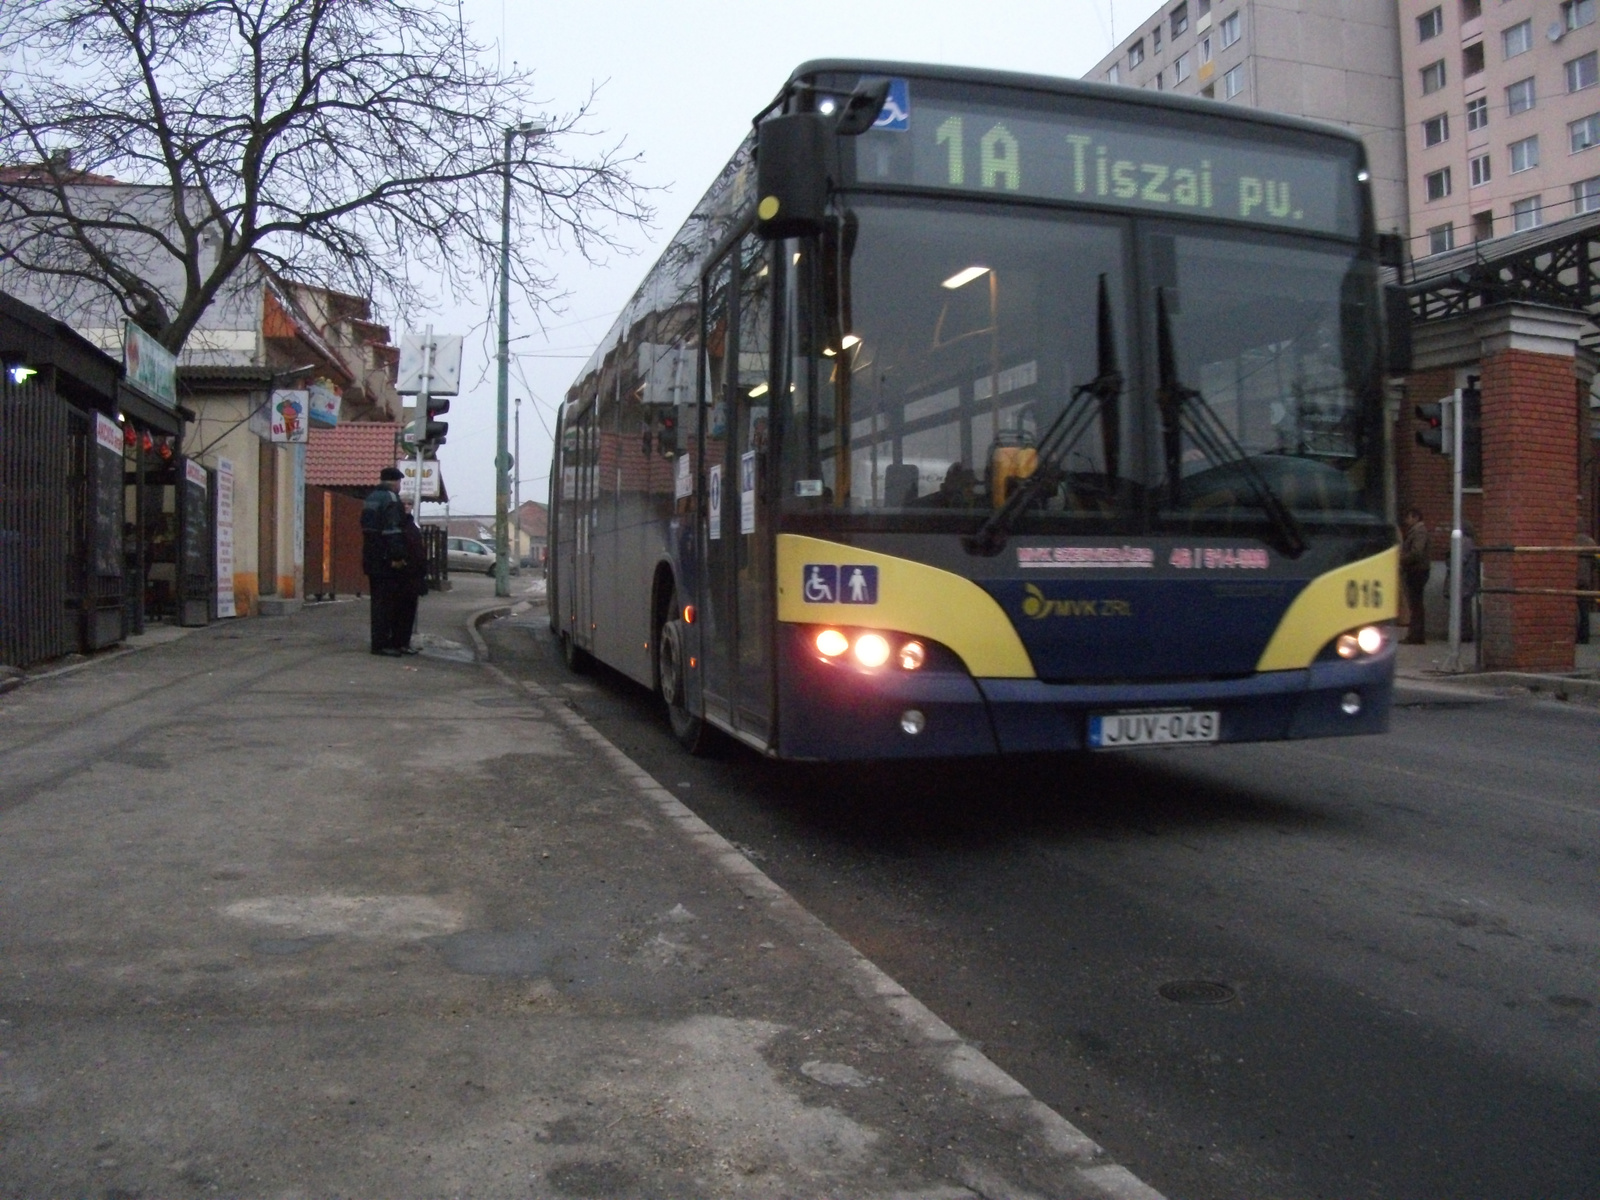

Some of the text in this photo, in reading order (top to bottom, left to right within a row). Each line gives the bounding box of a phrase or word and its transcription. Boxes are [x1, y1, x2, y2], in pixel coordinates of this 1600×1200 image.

[934, 115, 1304, 219] 1A Tiszai pu.
[1345, 579, 1384, 609] 016
[1106, 714, 1214, 742] JUV-049
